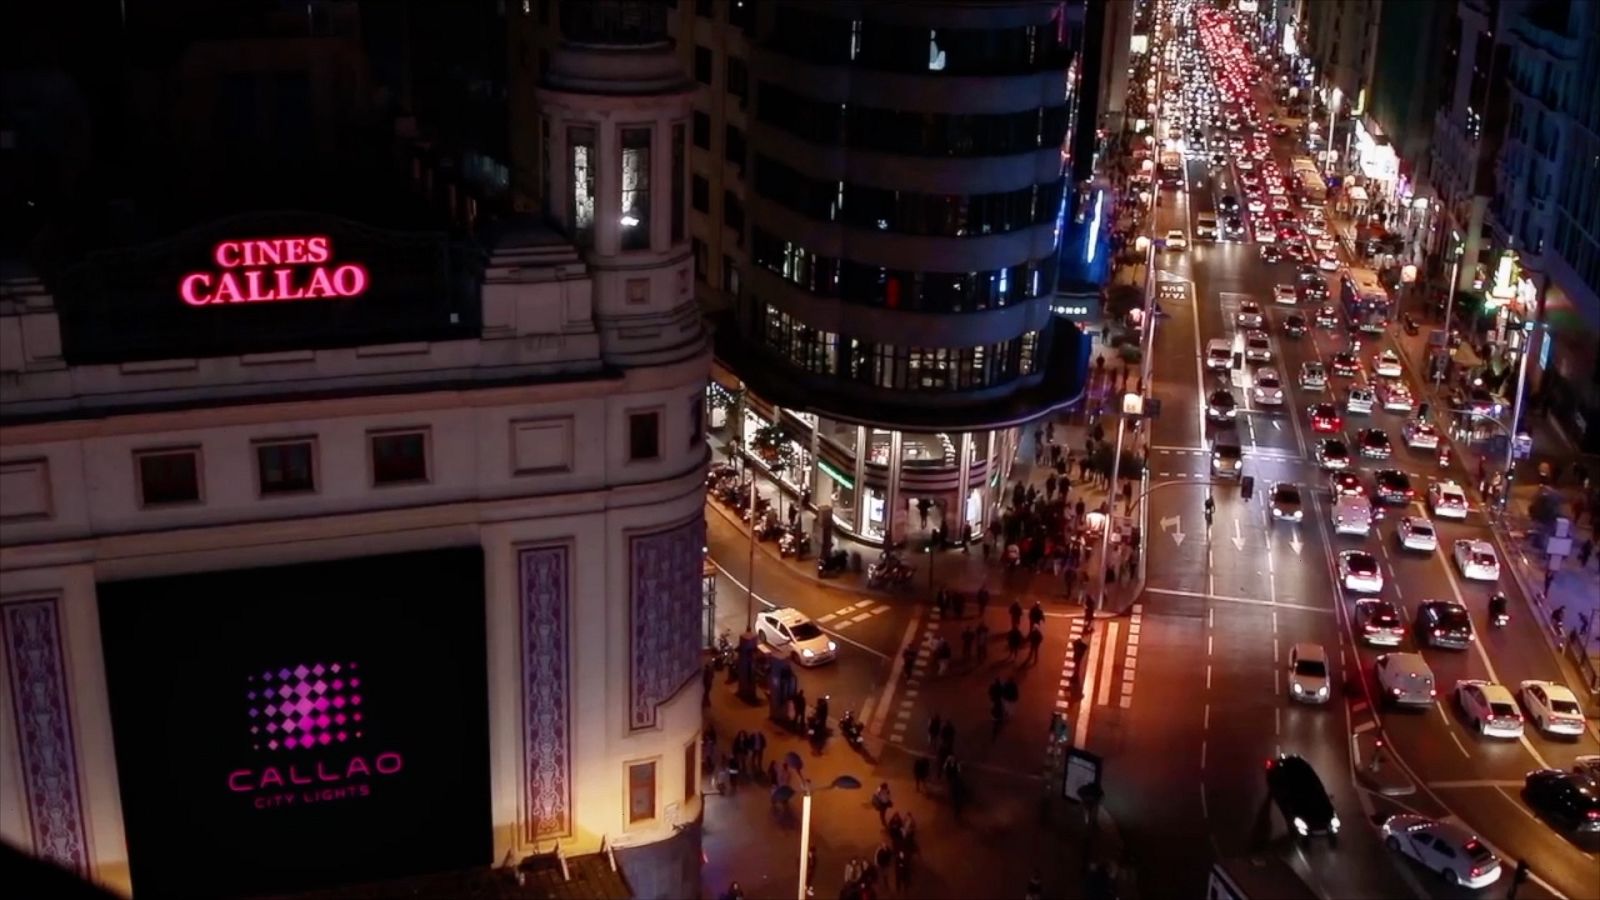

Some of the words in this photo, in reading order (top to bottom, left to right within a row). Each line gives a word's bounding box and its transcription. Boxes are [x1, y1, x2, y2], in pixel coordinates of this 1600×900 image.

[215, 237, 329, 268] CINES
[180, 264, 366, 306] CALLAO
[228, 752, 403, 791] CALLAO
[254, 793, 295, 809] CITY
[303, 784, 370, 803] LIGHTS
